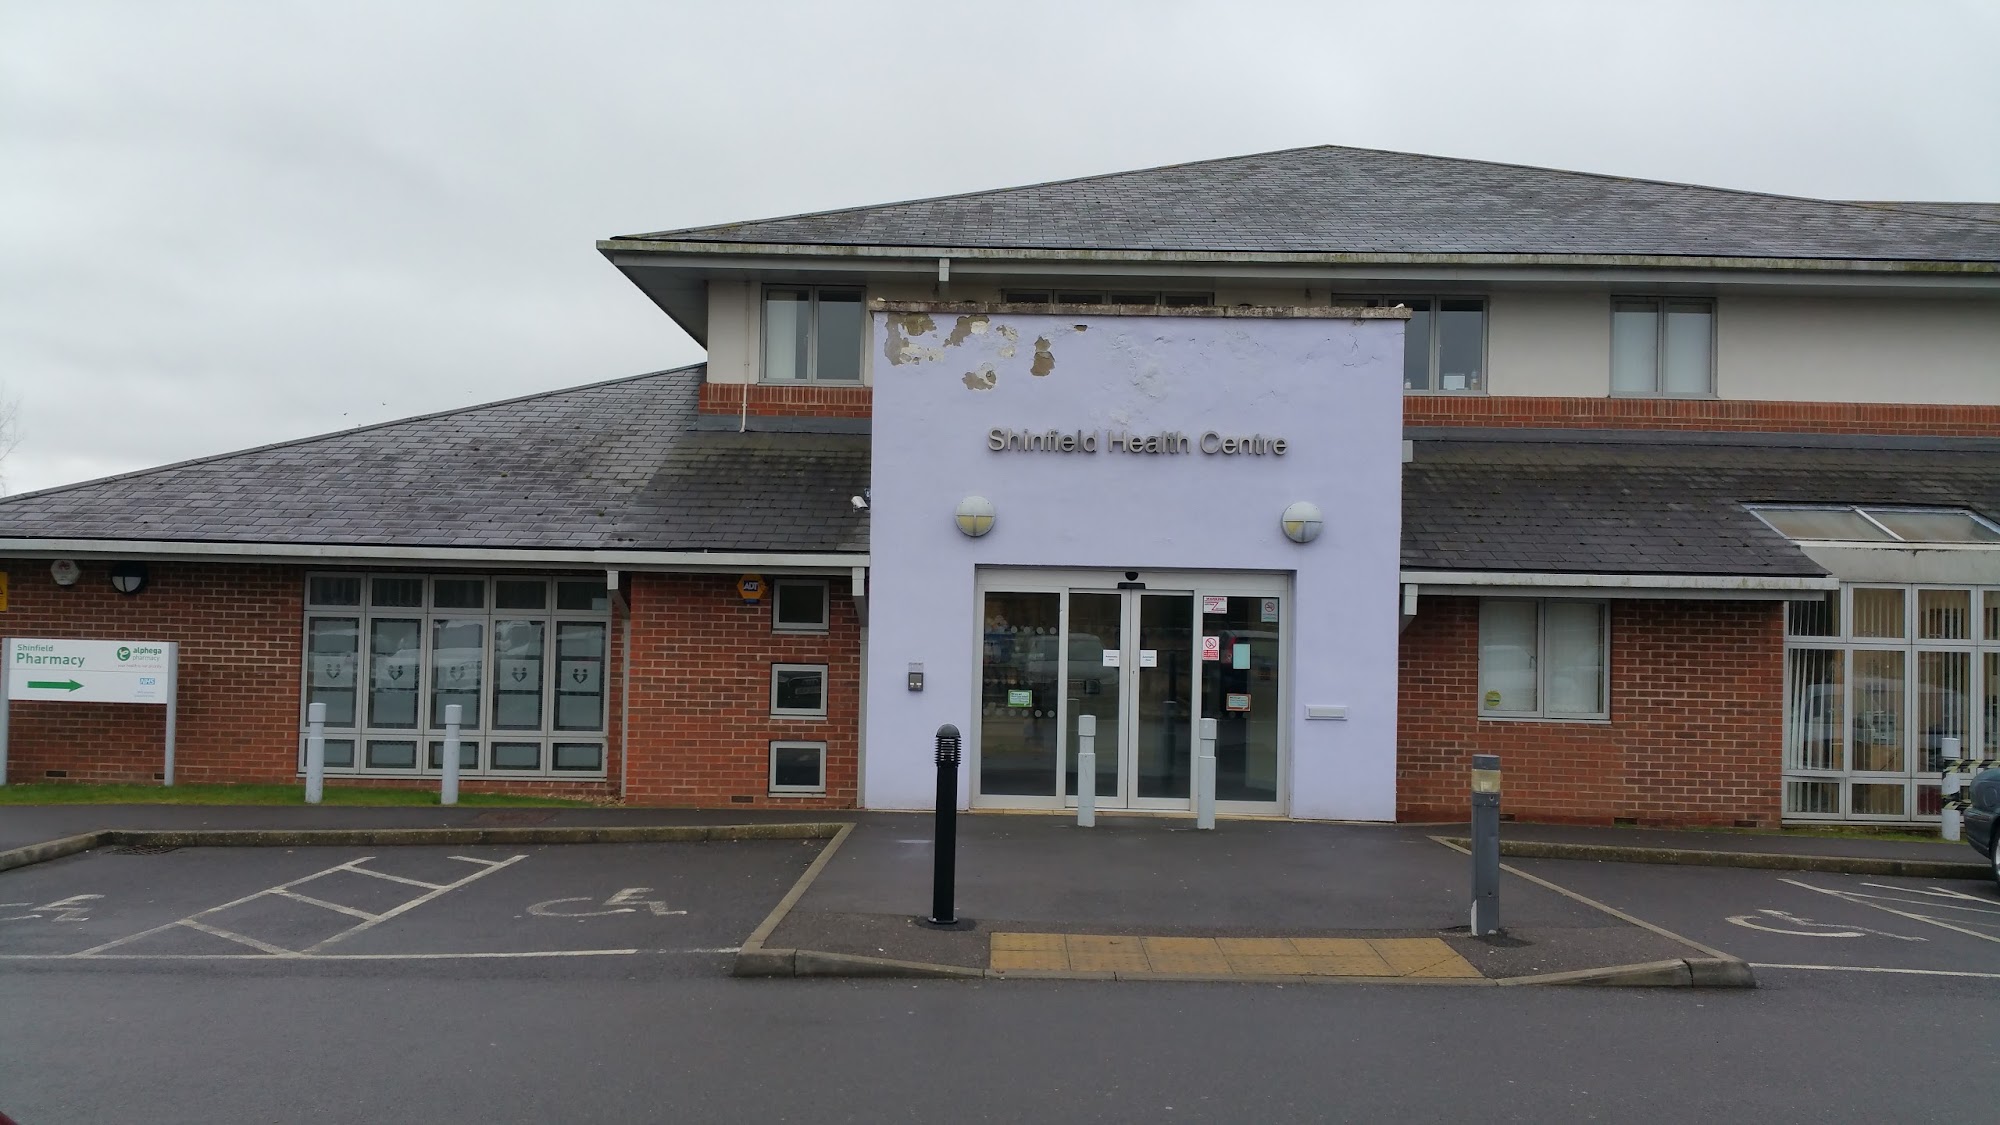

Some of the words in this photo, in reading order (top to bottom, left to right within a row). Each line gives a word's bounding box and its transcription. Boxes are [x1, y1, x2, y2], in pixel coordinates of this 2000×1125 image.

[987, 428, 1097, 453] Shinfield
[1108, 430, 1190, 454] Health
[1199, 431, 1288, 455] Centre
[743, 581, 758, 590] ADT
[17, 643, 54, 652] Shinfield
[133, 647, 162, 655] alphega
[16, 652, 85, 668] Pharmacy
